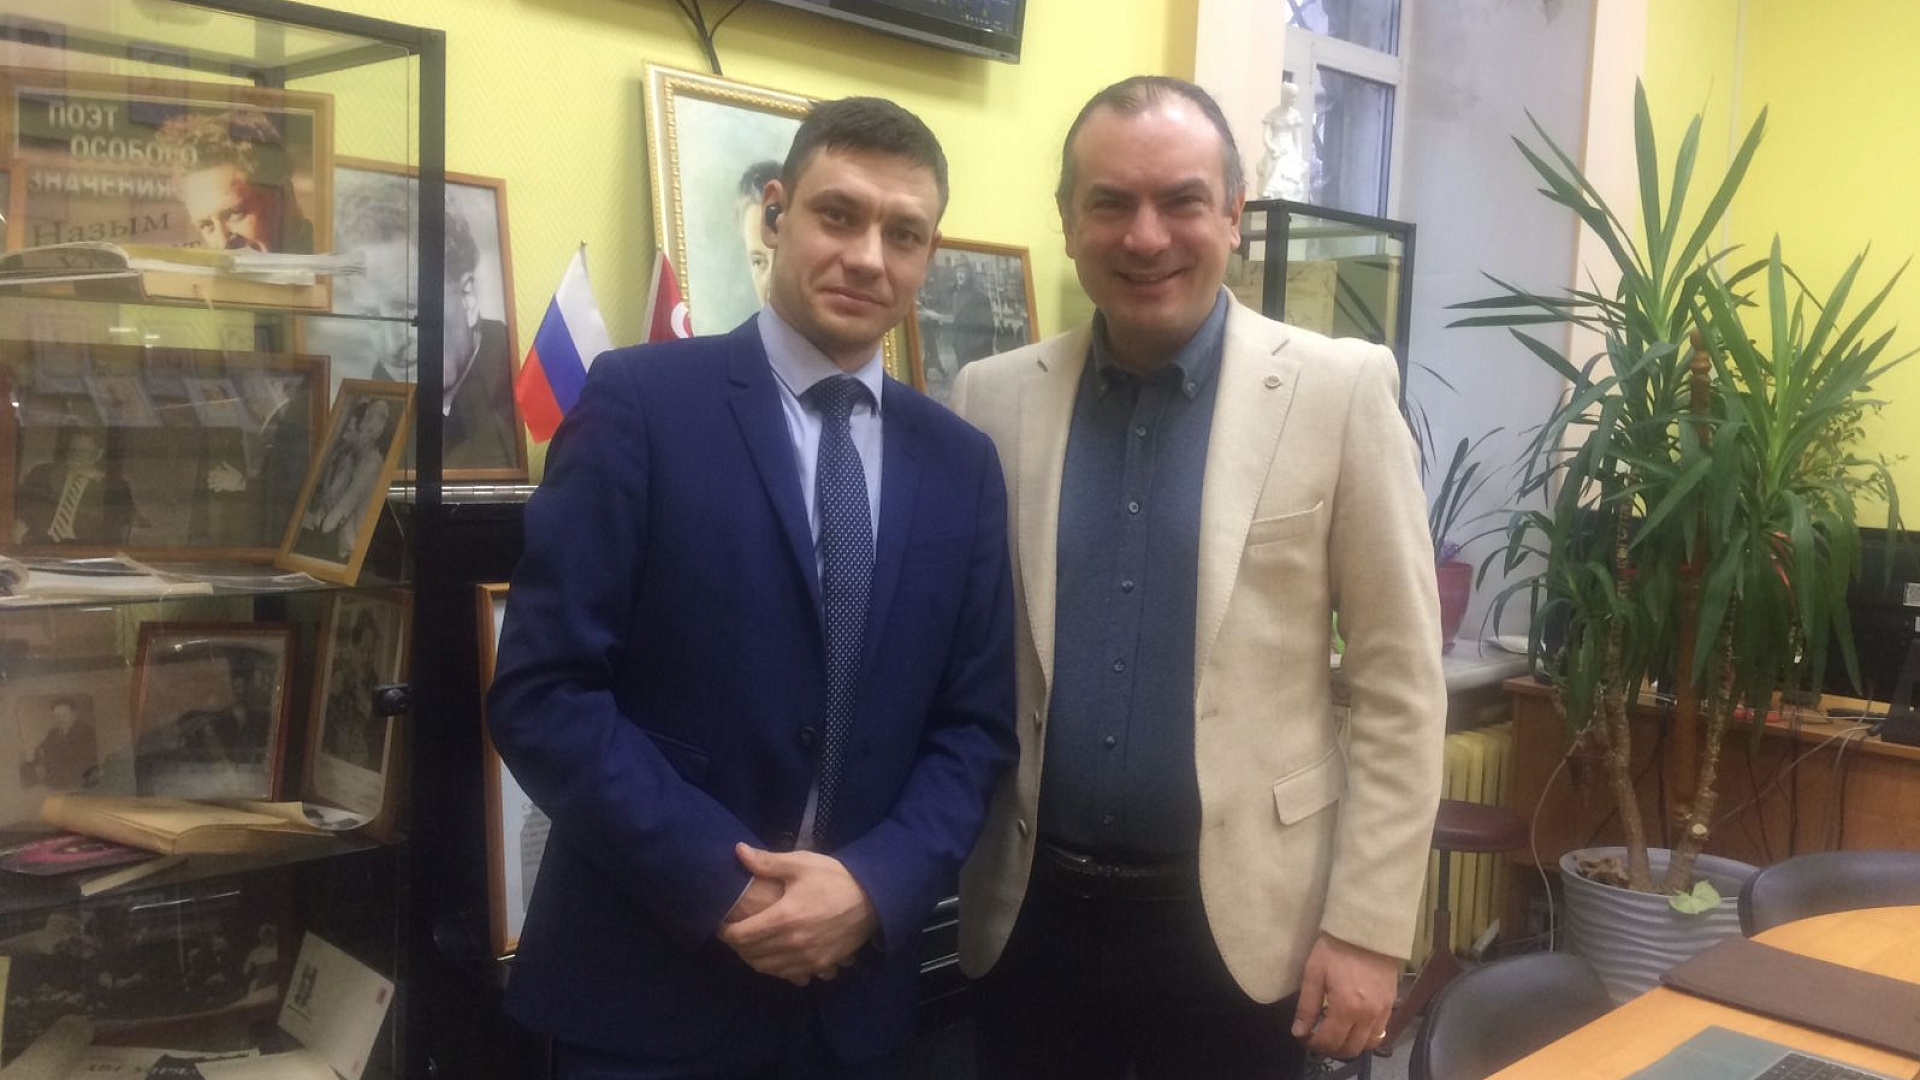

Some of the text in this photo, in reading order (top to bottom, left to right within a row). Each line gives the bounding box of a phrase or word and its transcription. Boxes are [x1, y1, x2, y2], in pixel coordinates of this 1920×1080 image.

[49, 101, 118, 131] ПОЭТ
[71, 134, 198, 168] ОСОБОГО
[29, 171, 172, 200] ЗНАЧЕНИЯ
[32, 212, 171, 246] Назым
